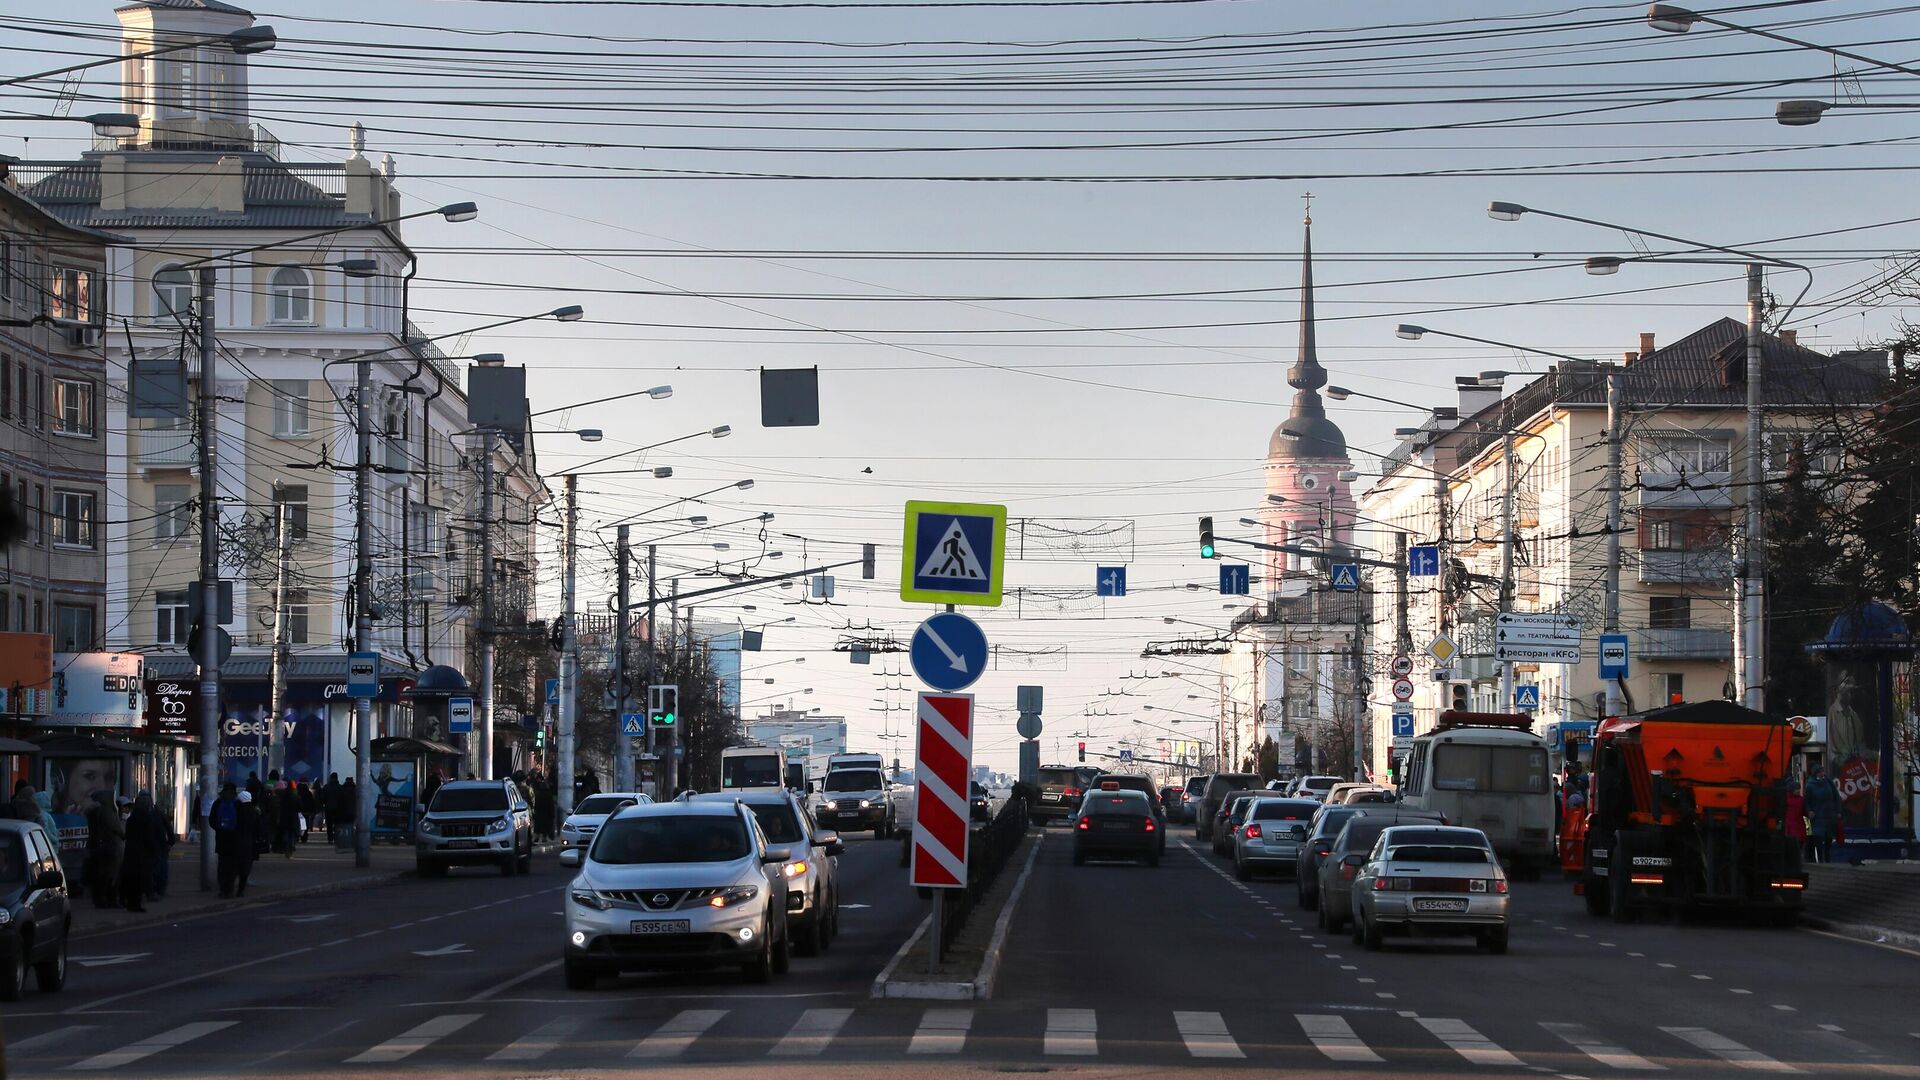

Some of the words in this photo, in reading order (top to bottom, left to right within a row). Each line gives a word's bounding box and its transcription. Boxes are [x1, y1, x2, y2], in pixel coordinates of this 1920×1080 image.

[1524, 617, 1565, 625] МОСКОВСКАЯ
[1507, 650, 1548, 660] ресторан
[1551, 650, 1578, 660] «KFC»
[156, 683, 192, 698] Дворец
[323, 684, 349, 699] GLOR
[224, 718, 297, 739] GeeJy
[1398, 716, 1410, 734] P
[218, 746, 270, 757] КСЕССУА
